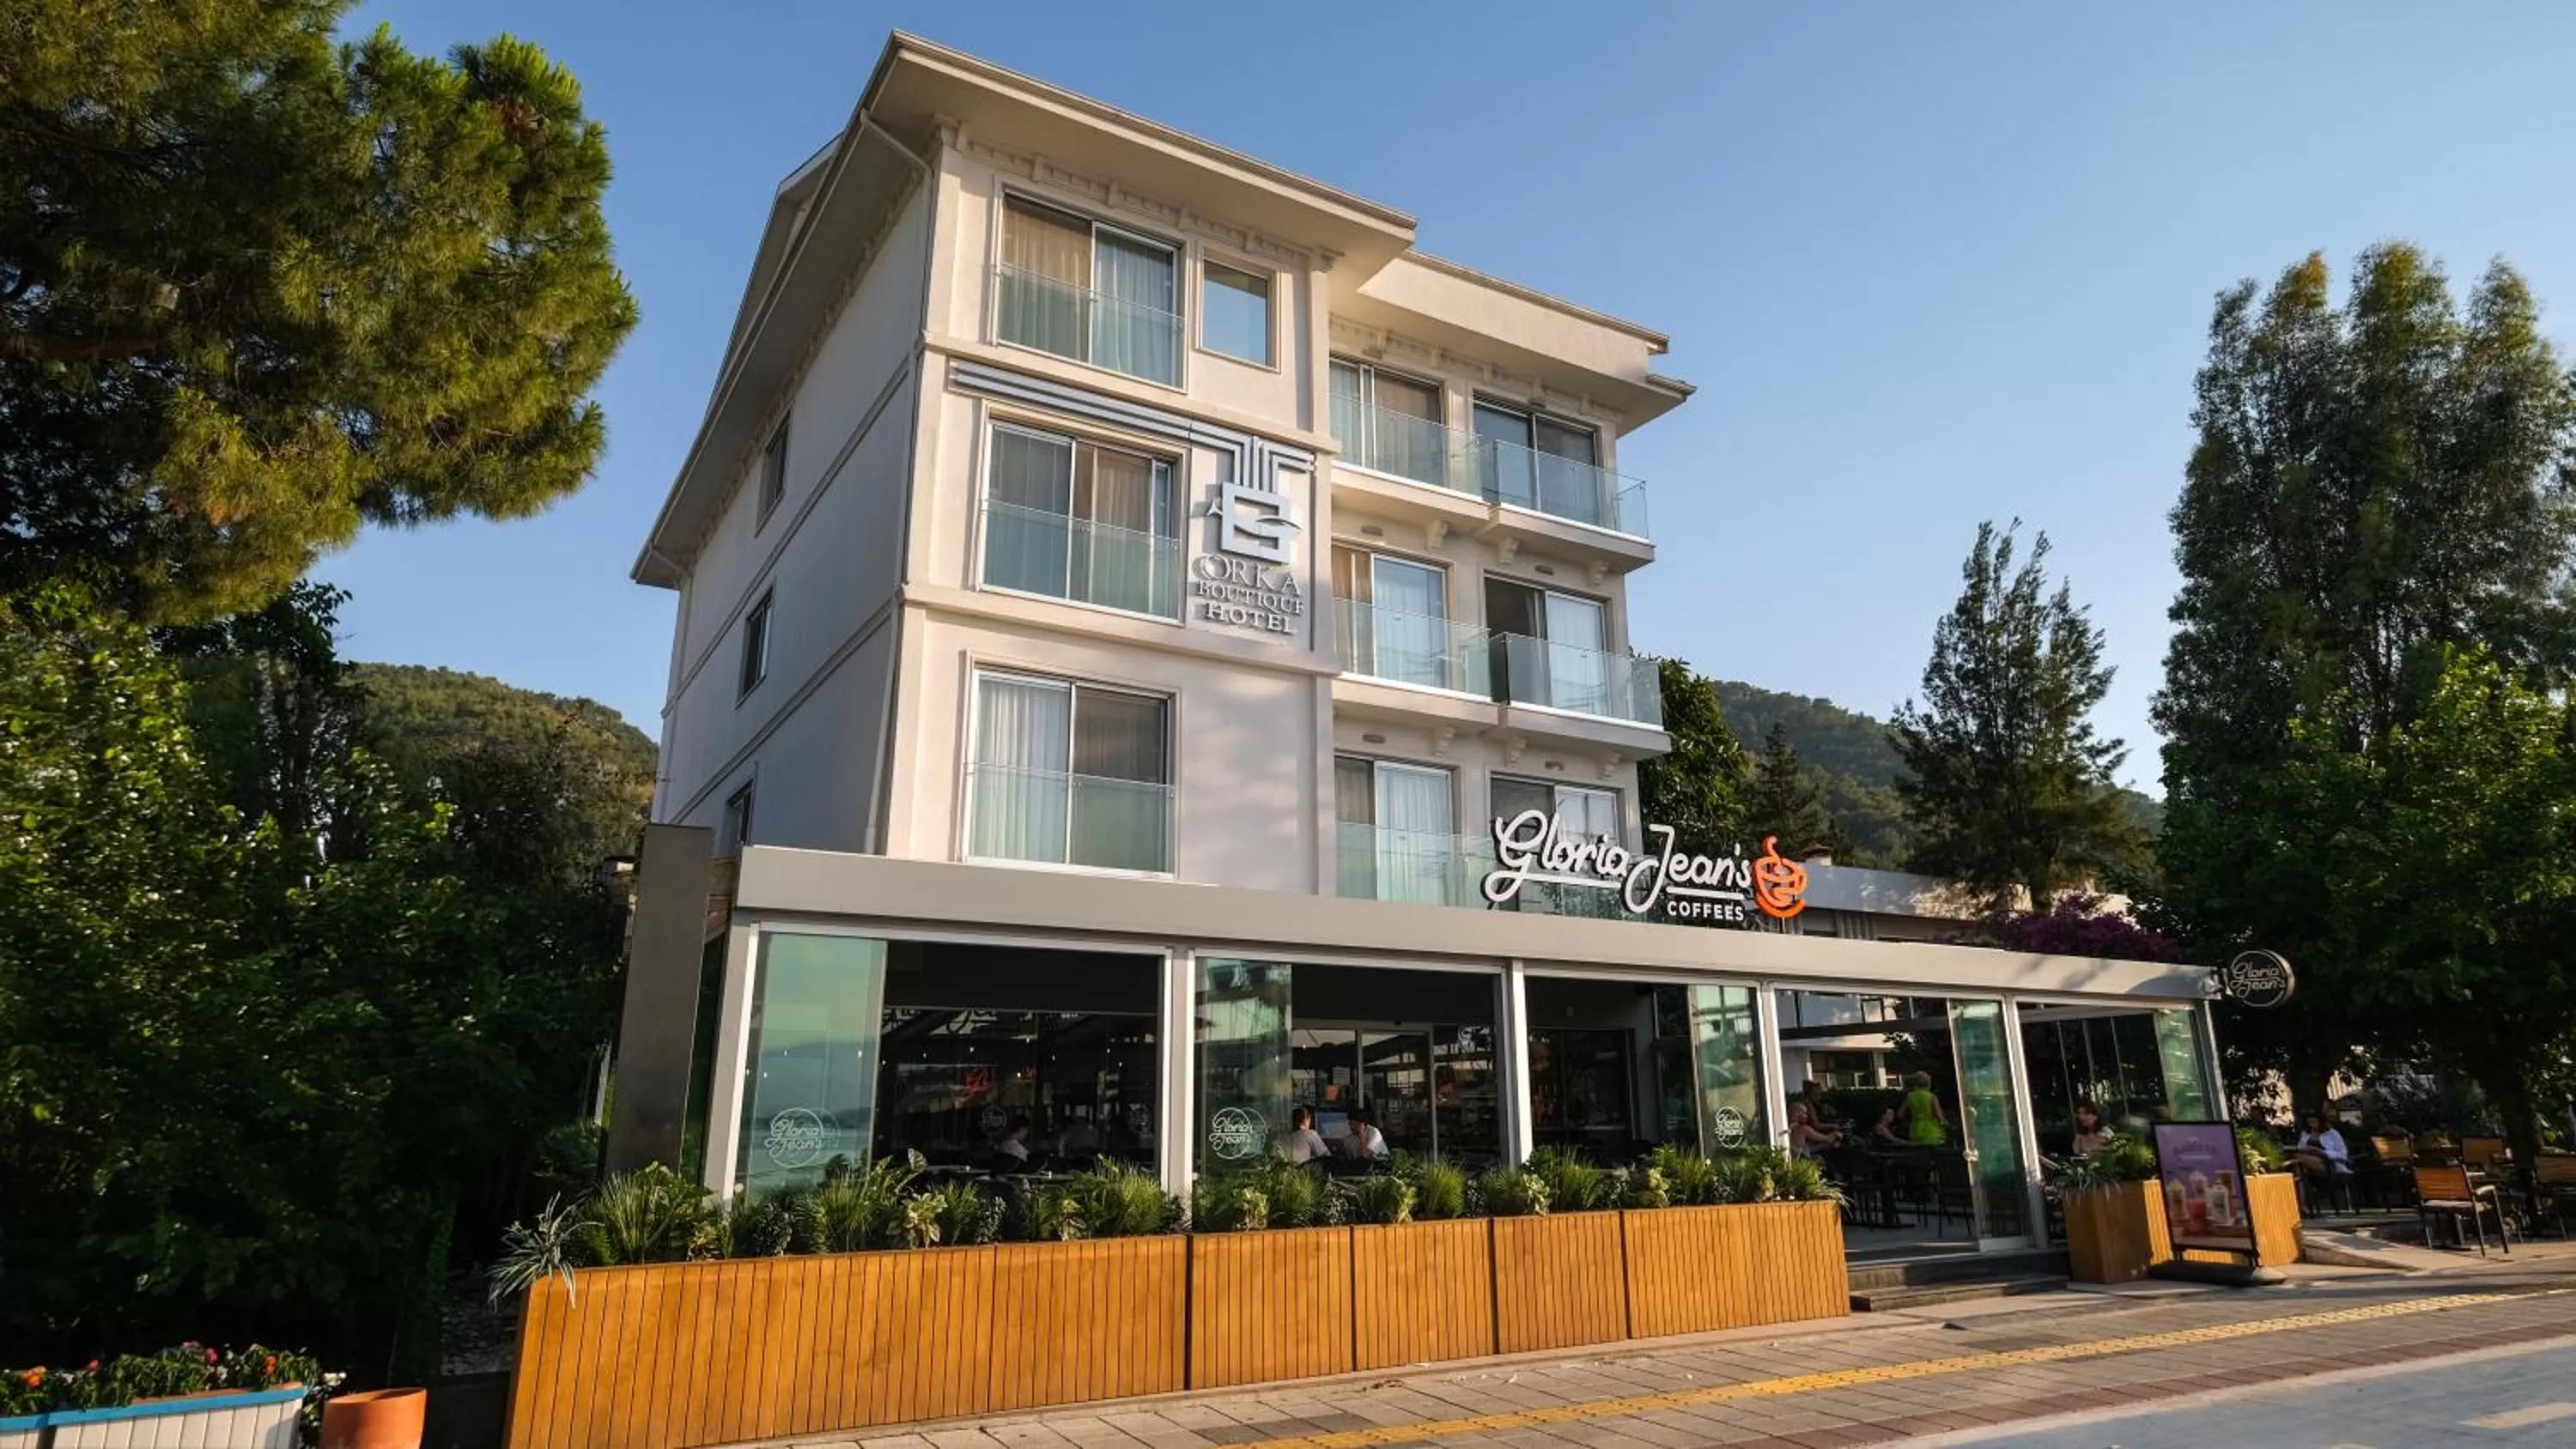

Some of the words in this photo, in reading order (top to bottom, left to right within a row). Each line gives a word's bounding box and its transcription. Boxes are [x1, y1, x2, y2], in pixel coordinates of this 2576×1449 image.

[1201, 554, 1301, 596] ORKA
[1198, 579, 1304, 615] BOUTIQUE
[1206, 601, 1298, 634] HOTEL
[1484, 809, 1629, 903] Gloria
[1624, 823, 1753, 913] Jean's
[1667, 900, 1745, 922] COFFEES
